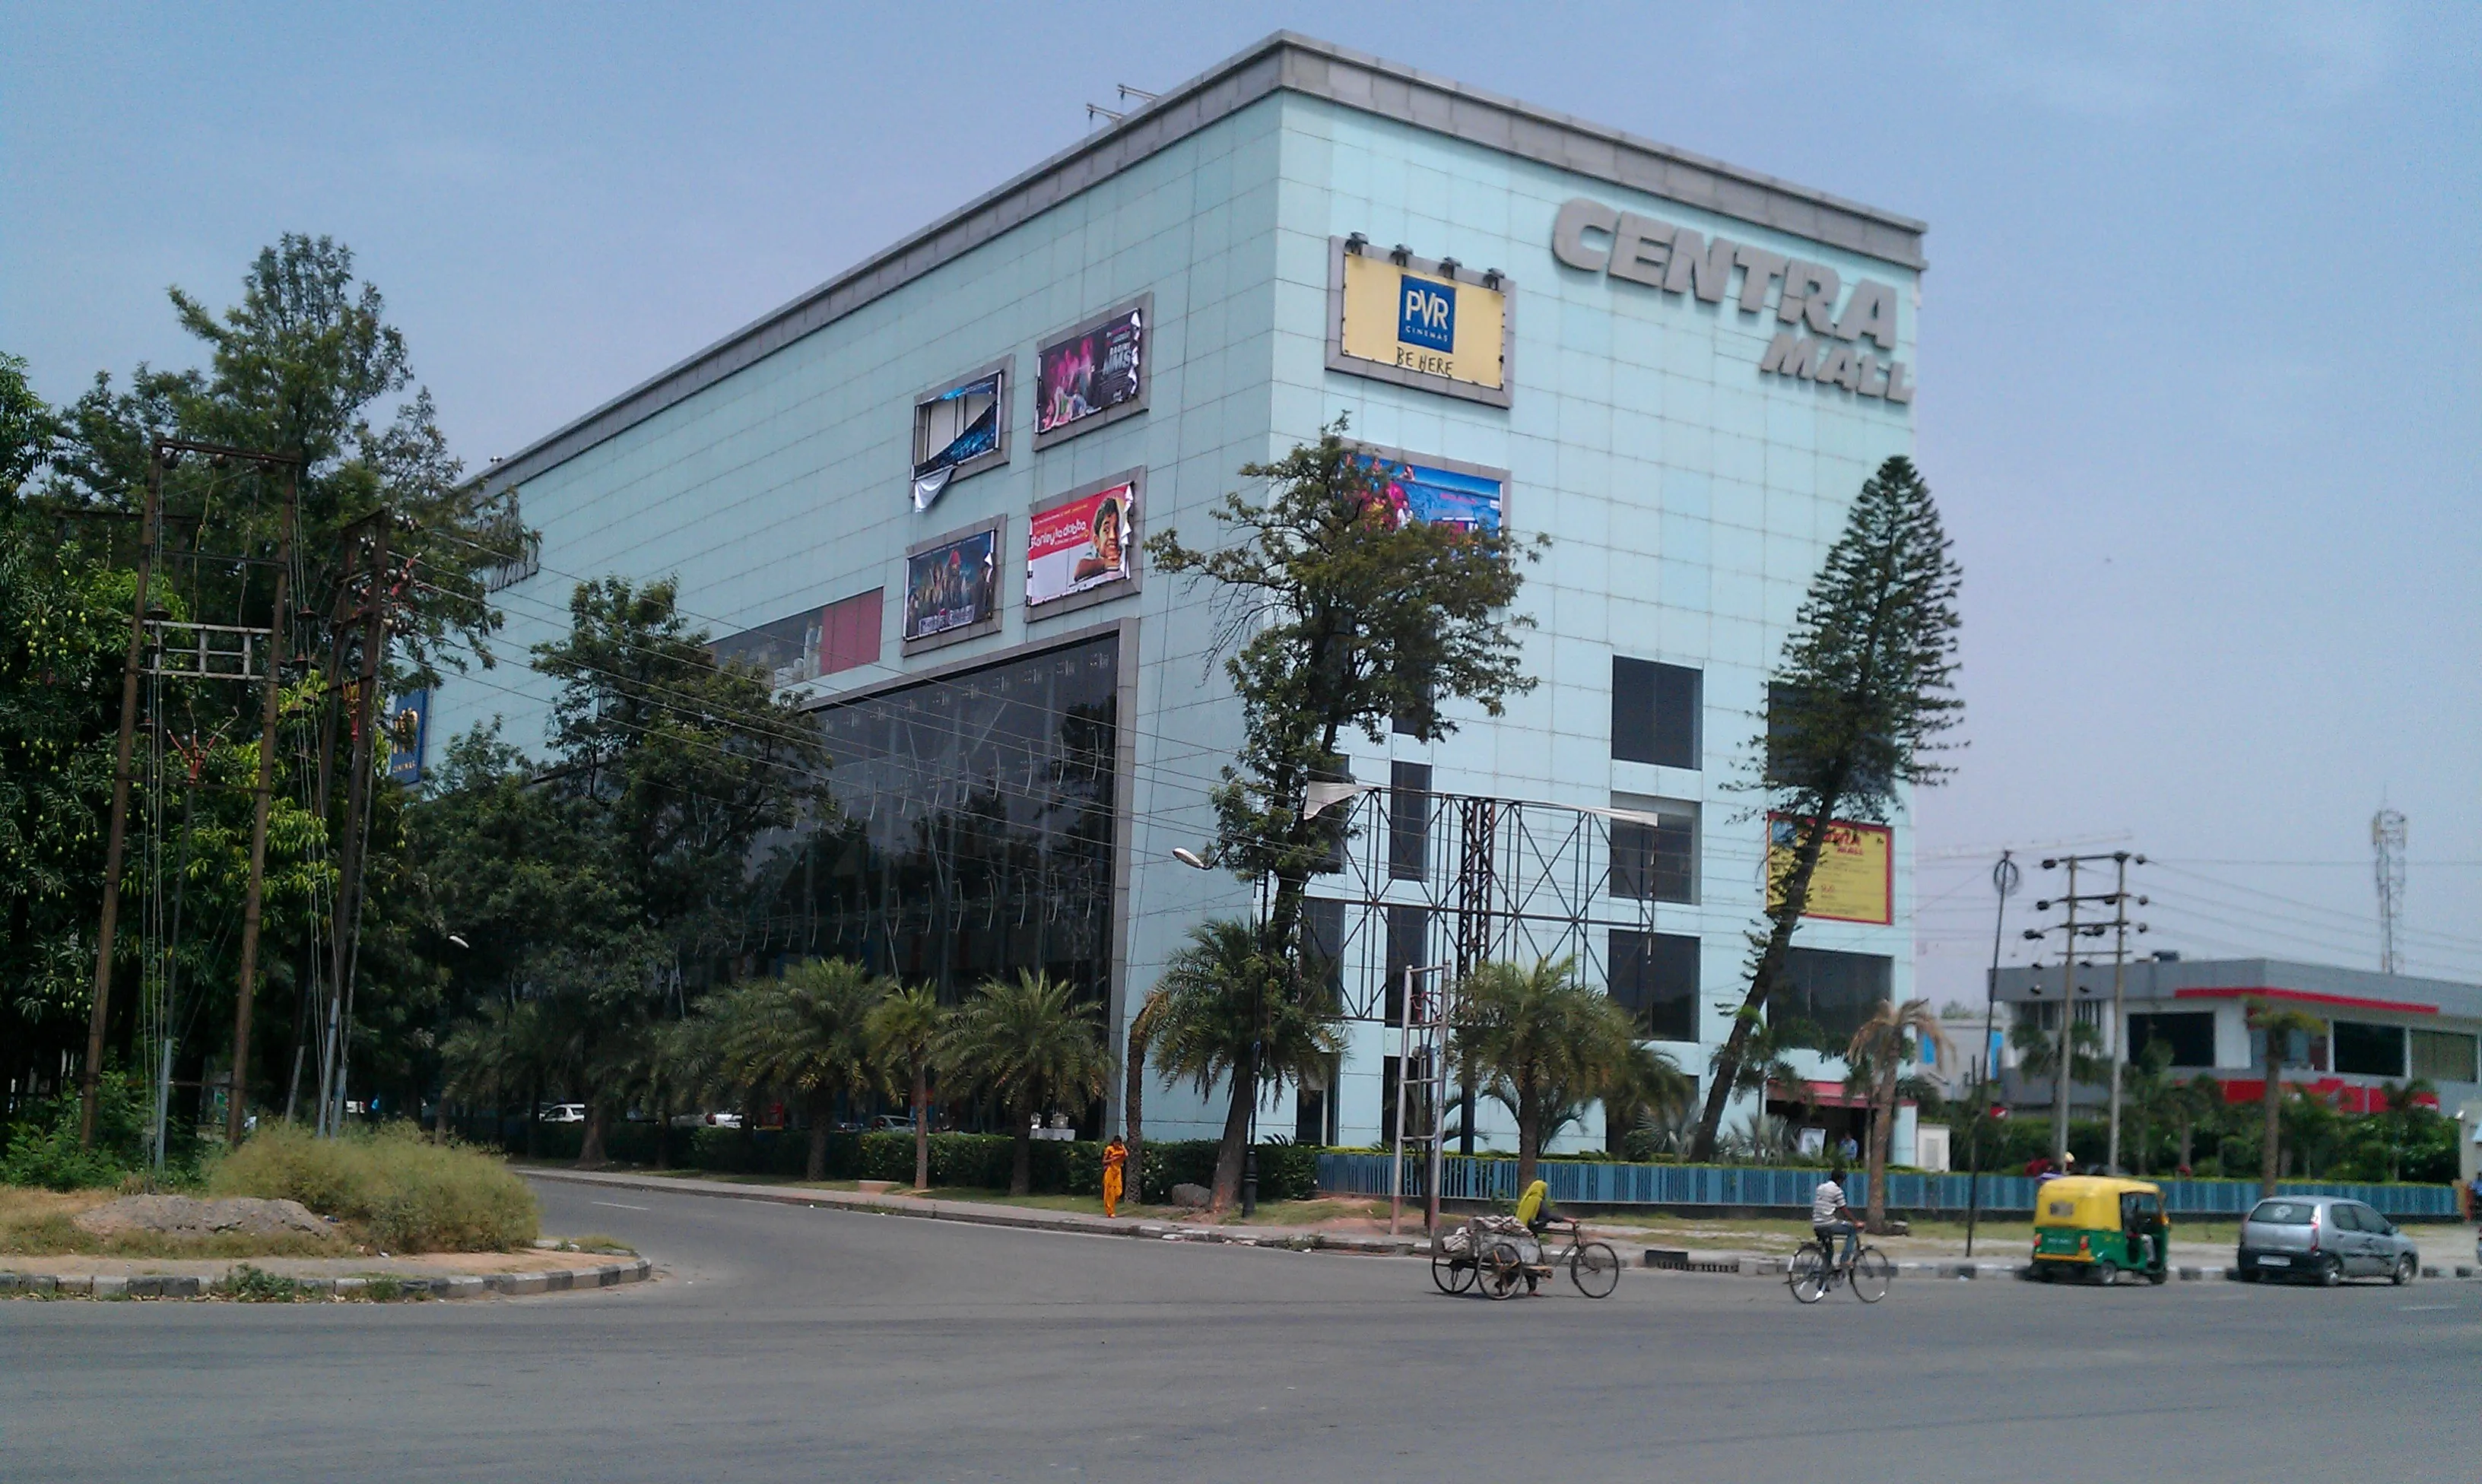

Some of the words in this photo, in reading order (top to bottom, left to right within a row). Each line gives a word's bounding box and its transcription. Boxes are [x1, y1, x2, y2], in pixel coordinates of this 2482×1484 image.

[1552, 197, 1898, 350] CENTRA
[1405, 289, 1449, 330] PVR
[1404, 325, 1449, 342] CINEMAS
[1396, 347, 1414, 366] BE
[1419, 354, 1454, 379] HERE
[1760, 332, 1914, 404] MALL
